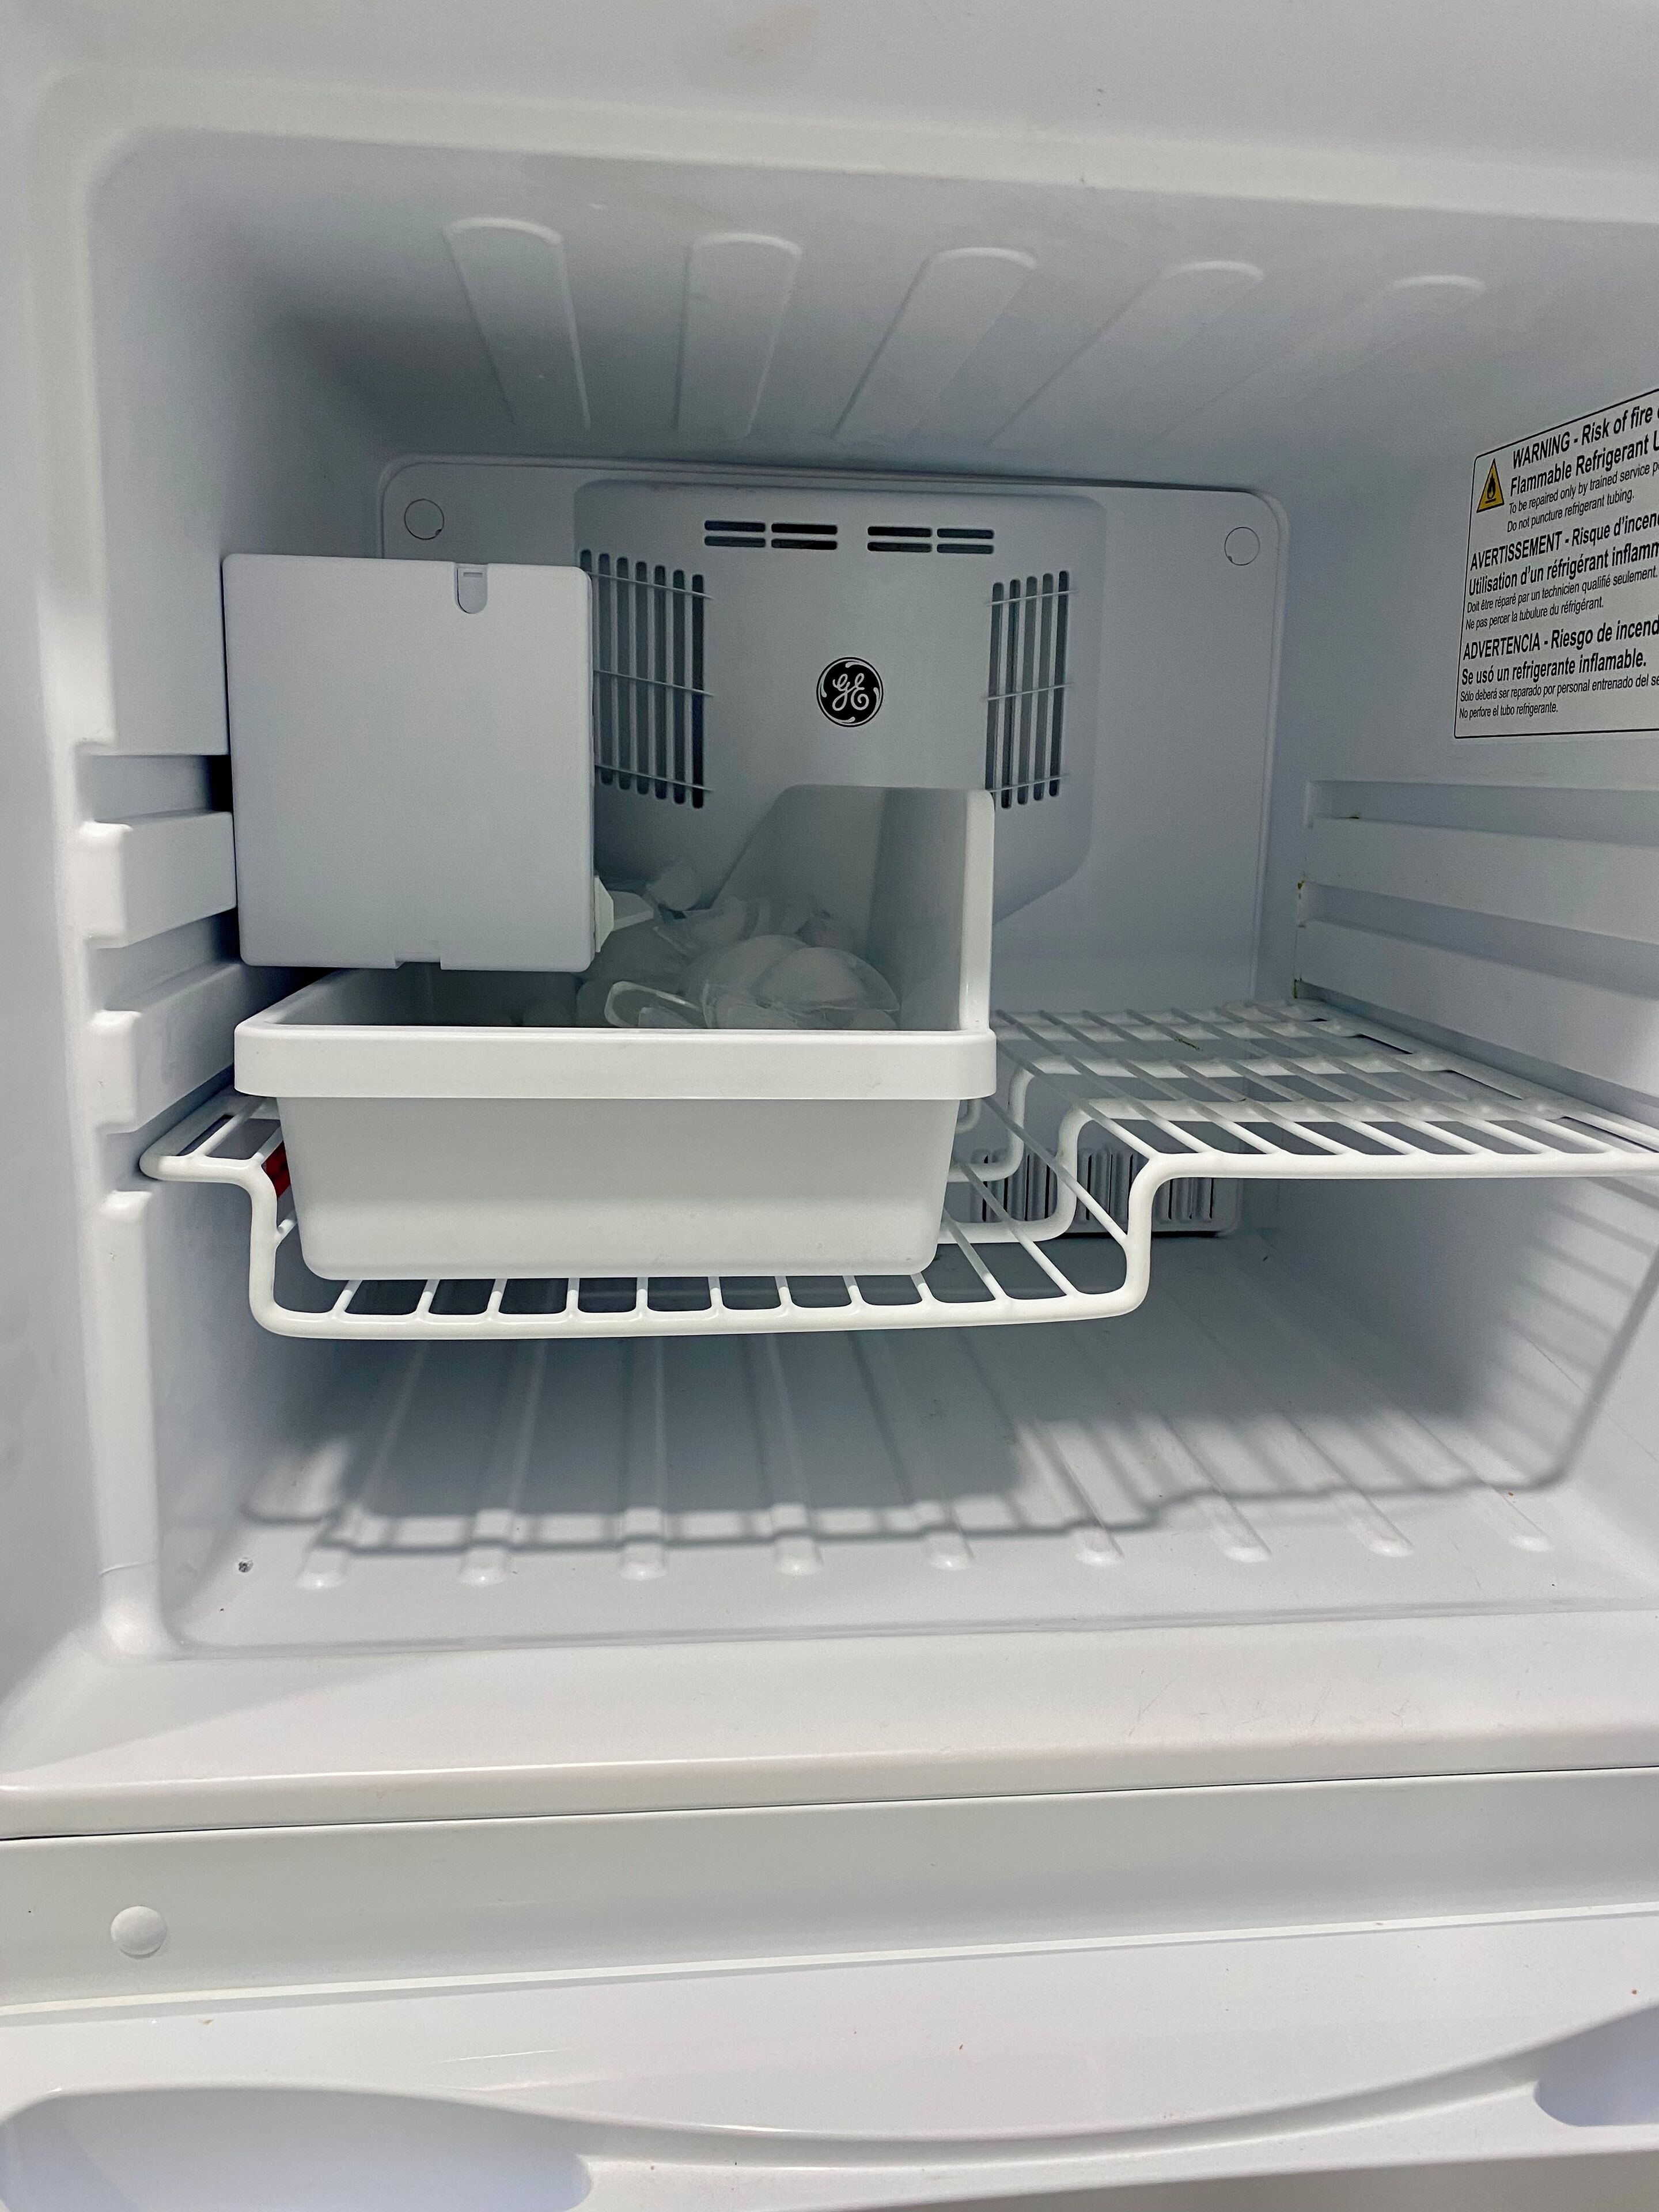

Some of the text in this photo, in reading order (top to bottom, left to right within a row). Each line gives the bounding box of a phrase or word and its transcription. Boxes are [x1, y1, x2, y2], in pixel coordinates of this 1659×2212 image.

[1513, 431, 1570, 469] WARNING
[1582, 418, 1610, 445] Risk
[1613, 410, 1628, 434] of
[1631, 406, 1653, 429] fire
[1510, 461, 1571, 497] Flammable
[1575, 434, 1649, 476] Refrigerant
[1508, 488, 1634, 532] Do not puncture refrigerant tubing.
[1509, 502, 1516, 514] To
[1518, 500, 1527, 512] be
[1529, 488, 1558, 510] repaired
[1560, 484, 1576, 499] only
[1578, 482, 1588, 496] by
[1590, 471, 1618, 491] trained
[1620, 464, 1650, 482] service
[1470, 531, 1562, 571] AVERTISSEMENT
[1571, 525, 1610, 547] Risque
[1614, 513, 1659, 536] d'incen
[1467, 565, 1658, 613] Doit être réparé par un technicien qualifié seulement.
[1469, 571, 1517, 596] Utilisation
[1521, 566, 1543, 585] d'un
[1547, 549, 1608, 580] réfrigérant
[1465, 596, 1604, 631] Ne pas percer la tubulure du réfrigérant.
[1463, 632, 1540, 661] ADVERTENCIA
[1551, 628, 1593, 650] Riesgo
[1597, 622, 1612, 643] de
[1461, 648, 1646, 685] Se usó un refrigerante inflamable.
[1475, 688, 1497, 700] deberá
[1499, 690, 1510, 699] ser
[1511, 684, 1541, 700] reparado
[1543, 685, 1556, 698] por
[1557, 679, 1590, 697] personal
[1592, 676, 1633, 691] entrenado
[1636, 673, 1649, 687] del
[1460, 702, 1558, 721] No perfore el tubo refrigerante.
